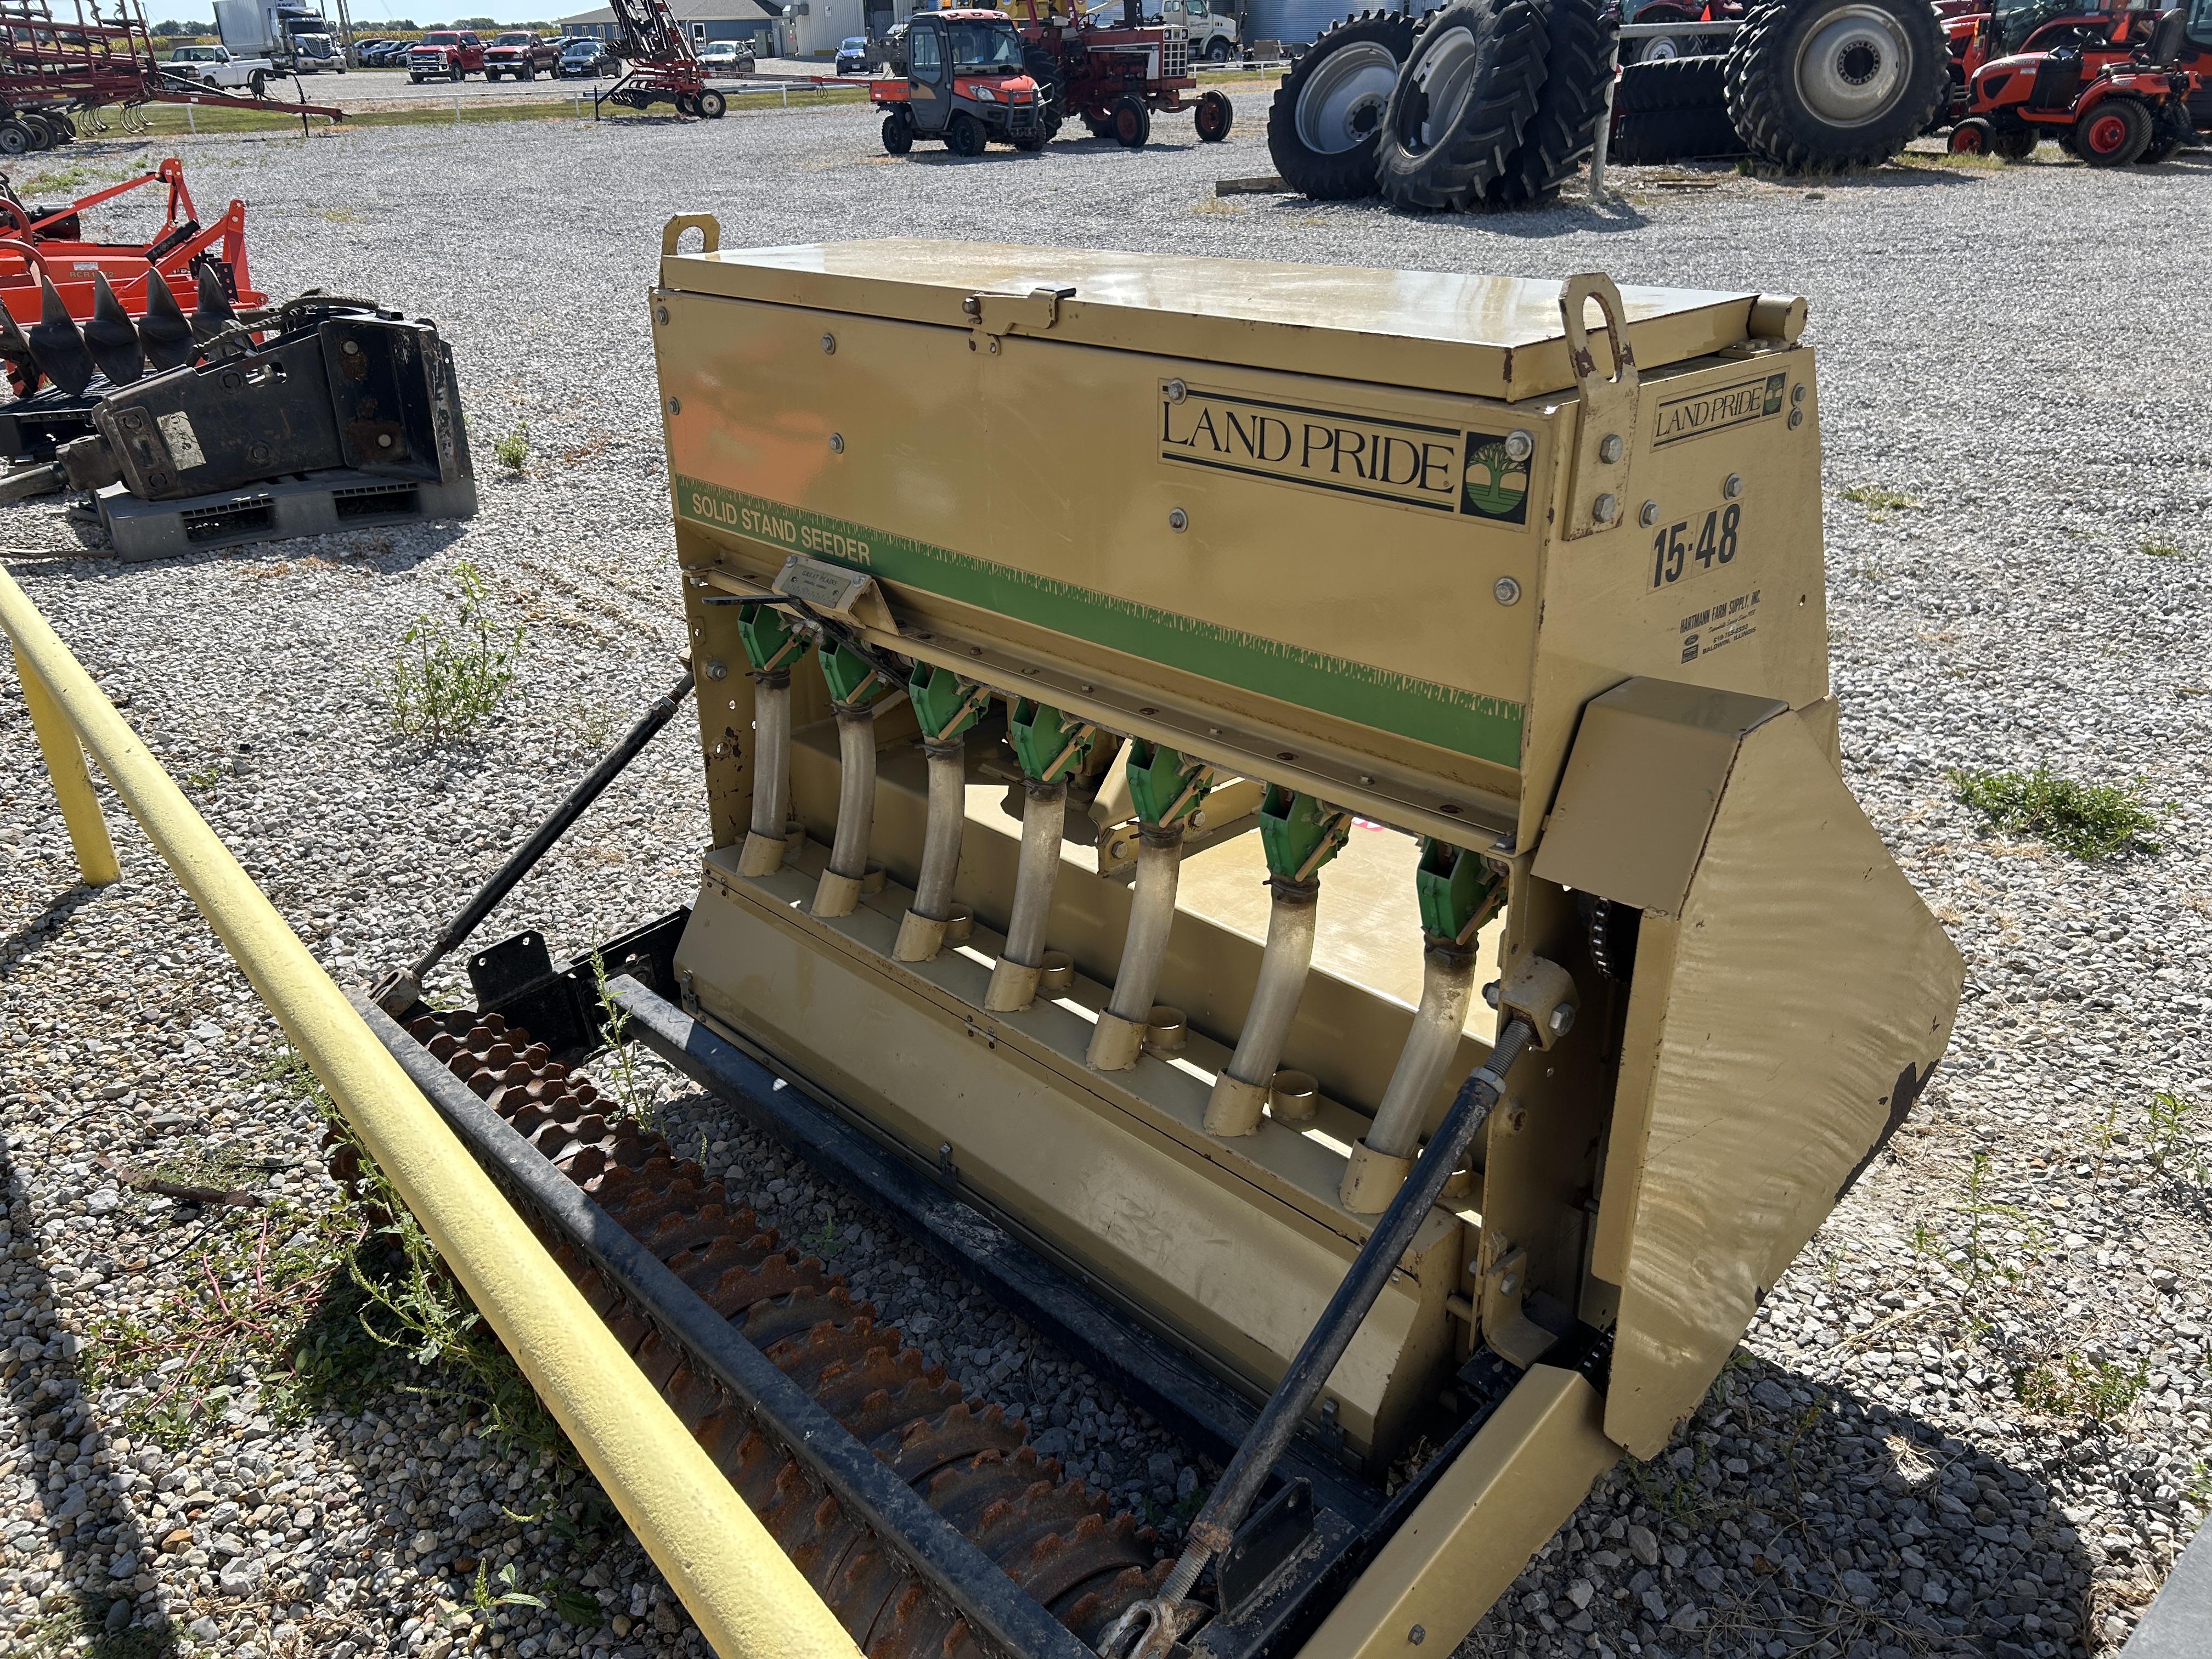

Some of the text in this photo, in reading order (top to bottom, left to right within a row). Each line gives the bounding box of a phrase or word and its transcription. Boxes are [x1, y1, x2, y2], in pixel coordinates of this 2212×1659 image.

[1655, 387, 1763, 437] LAND PRIDE
[1162, 401, 1455, 494] LAND PRIDE
[692, 493, 871, 567] SOLID STAND SEEDER
[802, 571, 819, 580] GREAT
[820, 576, 838, 586] PLAINS
[1680, 609, 1711, 634] HARTMANN
[1712, 602, 1728, 622] FARM
[1729, 594, 1750, 615] SUPPLY,
[1734, 627, 1756, 641] ILLINOIS
